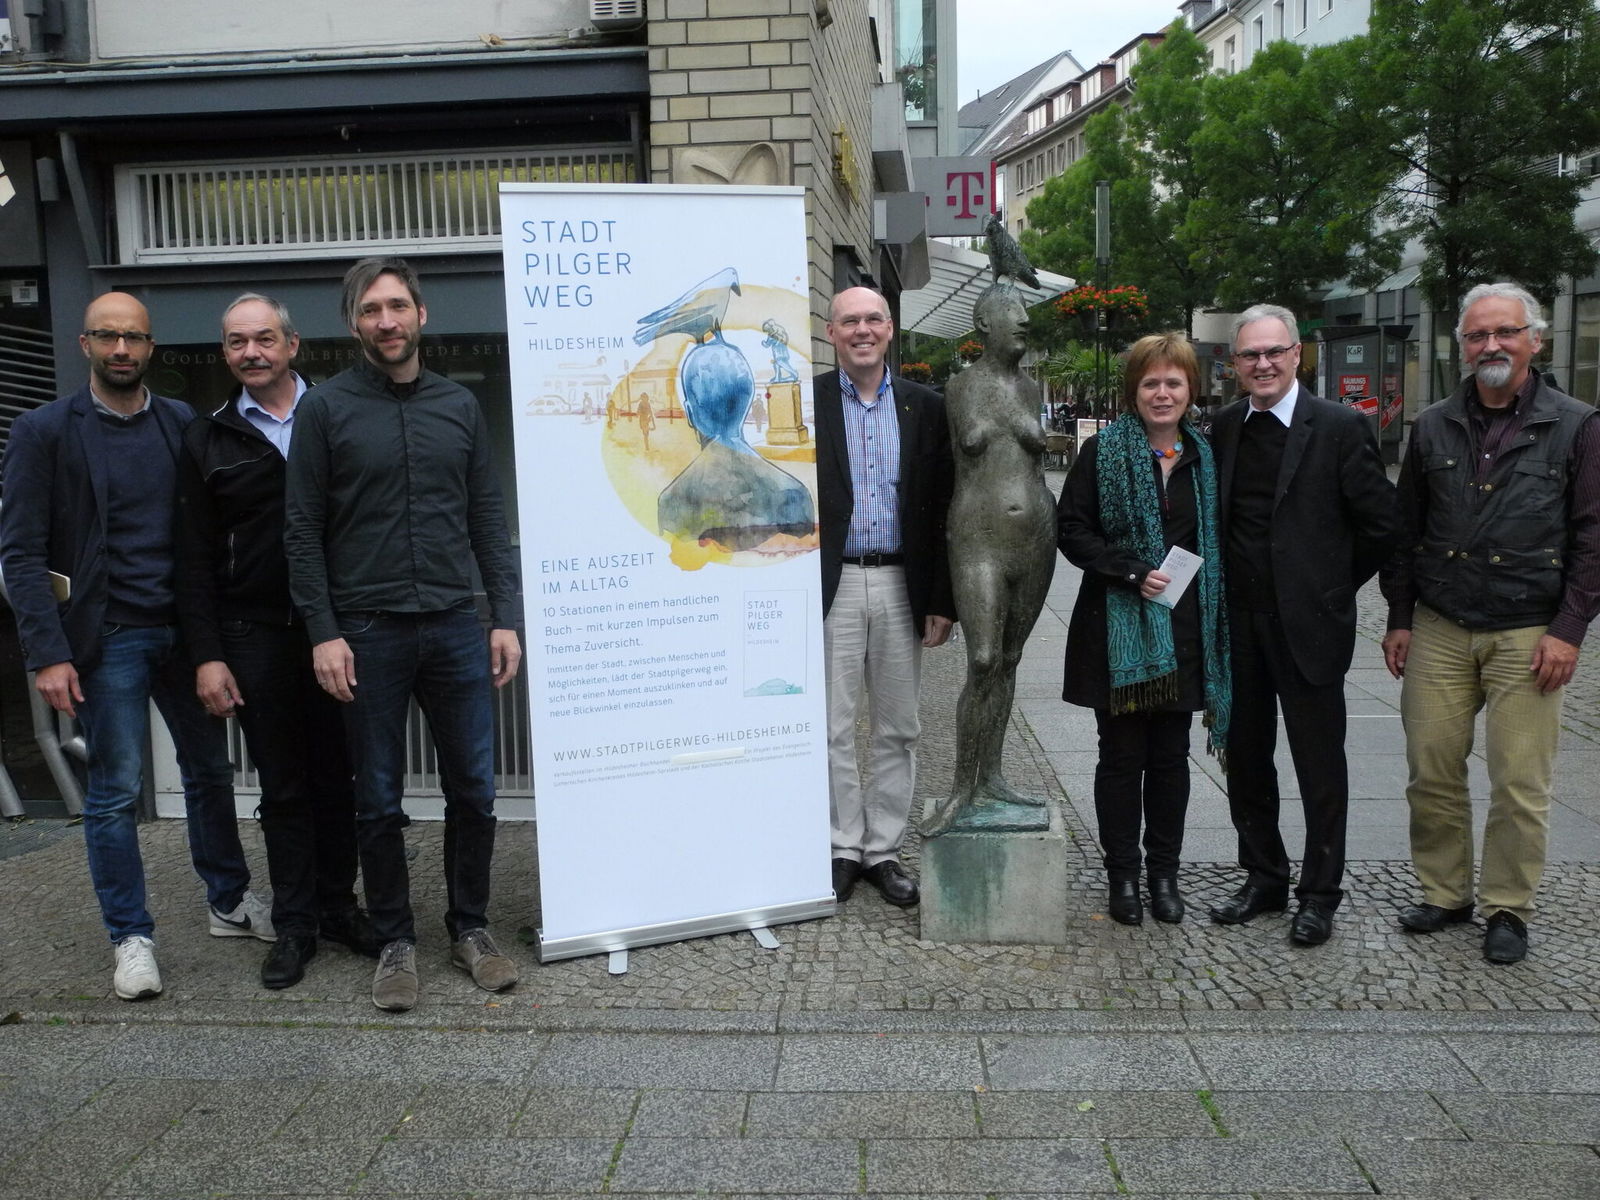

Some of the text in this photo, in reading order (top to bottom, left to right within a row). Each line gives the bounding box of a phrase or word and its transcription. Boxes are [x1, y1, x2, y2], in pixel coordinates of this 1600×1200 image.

[522, 220, 617, 243] STADT
[525, 252, 631, 275] PILGER
[524, 285, 593, 308] WEG
[528, 337, 624, 351] HILDESHEIM
[541, 552, 655, 573] EINE AUSZEIT
[542, 575, 629, 595] IM ALLTAG
[543, 594, 720, 618] 10 Stationen in einem handlichen
[747, 600, 778, 610] STADT
[747, 610, 784, 620] PILGER
[545, 624, 572, 636] Buch
[586, 622, 604, 632] mit
[607, 619, 643, 630] kurzen
[646, 615, 695, 628] Impulsen
[698, 612, 719, 623] zum
[747, 621, 770, 631] WEG
[544, 637, 644, 655] Thema Zuversicht.
[547, 664, 583, 674] Inmitten
[585, 662, 598, 671] der
[628, 655, 666, 667] zwischen
[668, 650, 709, 661] Menschen
[711, 649, 726, 658] und
[611, 673, 629, 682] lädt
[631, 671, 645, 680] der
[648, 666, 712, 679] Stadtpilgerweg
[548, 677, 728, 703] sich für einen Moment auszuklinken und auf
[549, 708, 571, 718] neue
[573, 703, 621, 716] Blickwinkel
[554, 722, 811, 762] WWW.STADTPILGERWEG-HILDESHEIM.DE
